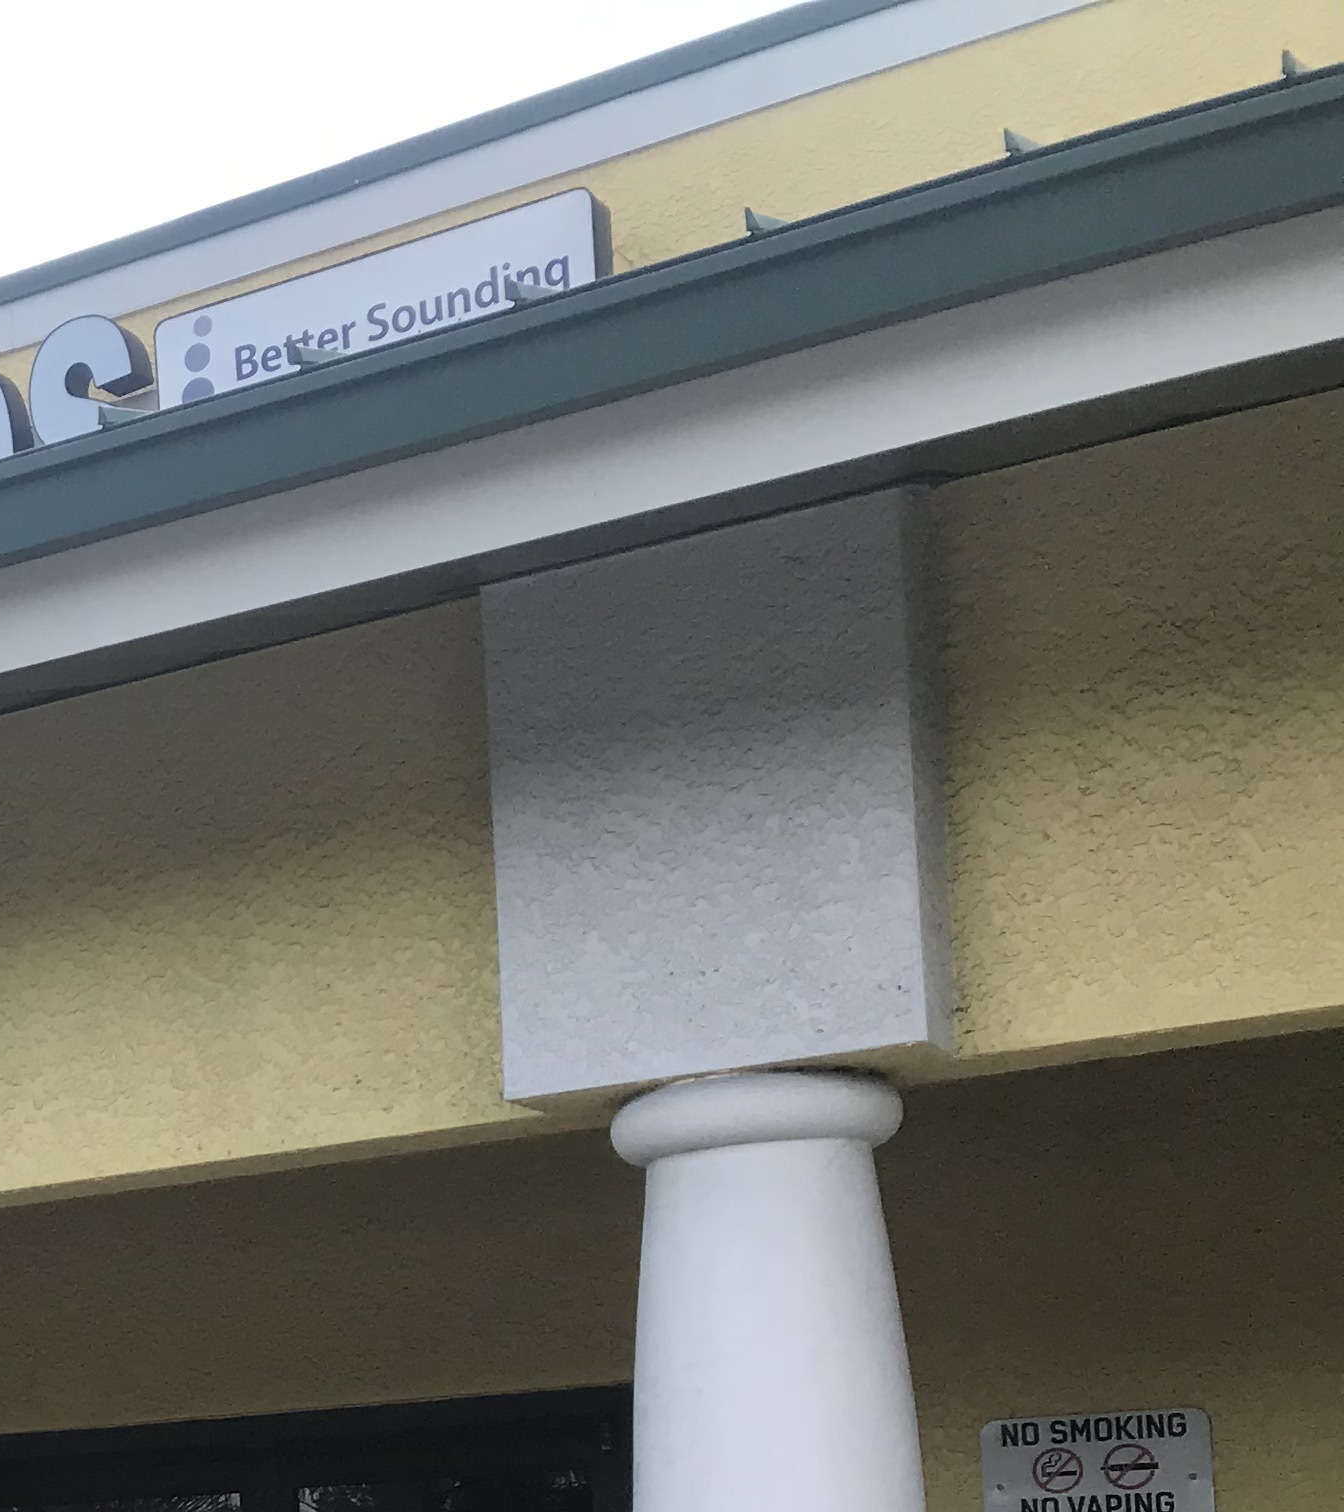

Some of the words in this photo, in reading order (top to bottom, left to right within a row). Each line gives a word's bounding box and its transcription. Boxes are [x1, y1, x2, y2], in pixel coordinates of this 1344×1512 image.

[234, 320, 356, 381] Better
[1001, 1421, 1040, 1447] NO
[1050, 1412, 1187, 1445] SMOKING
